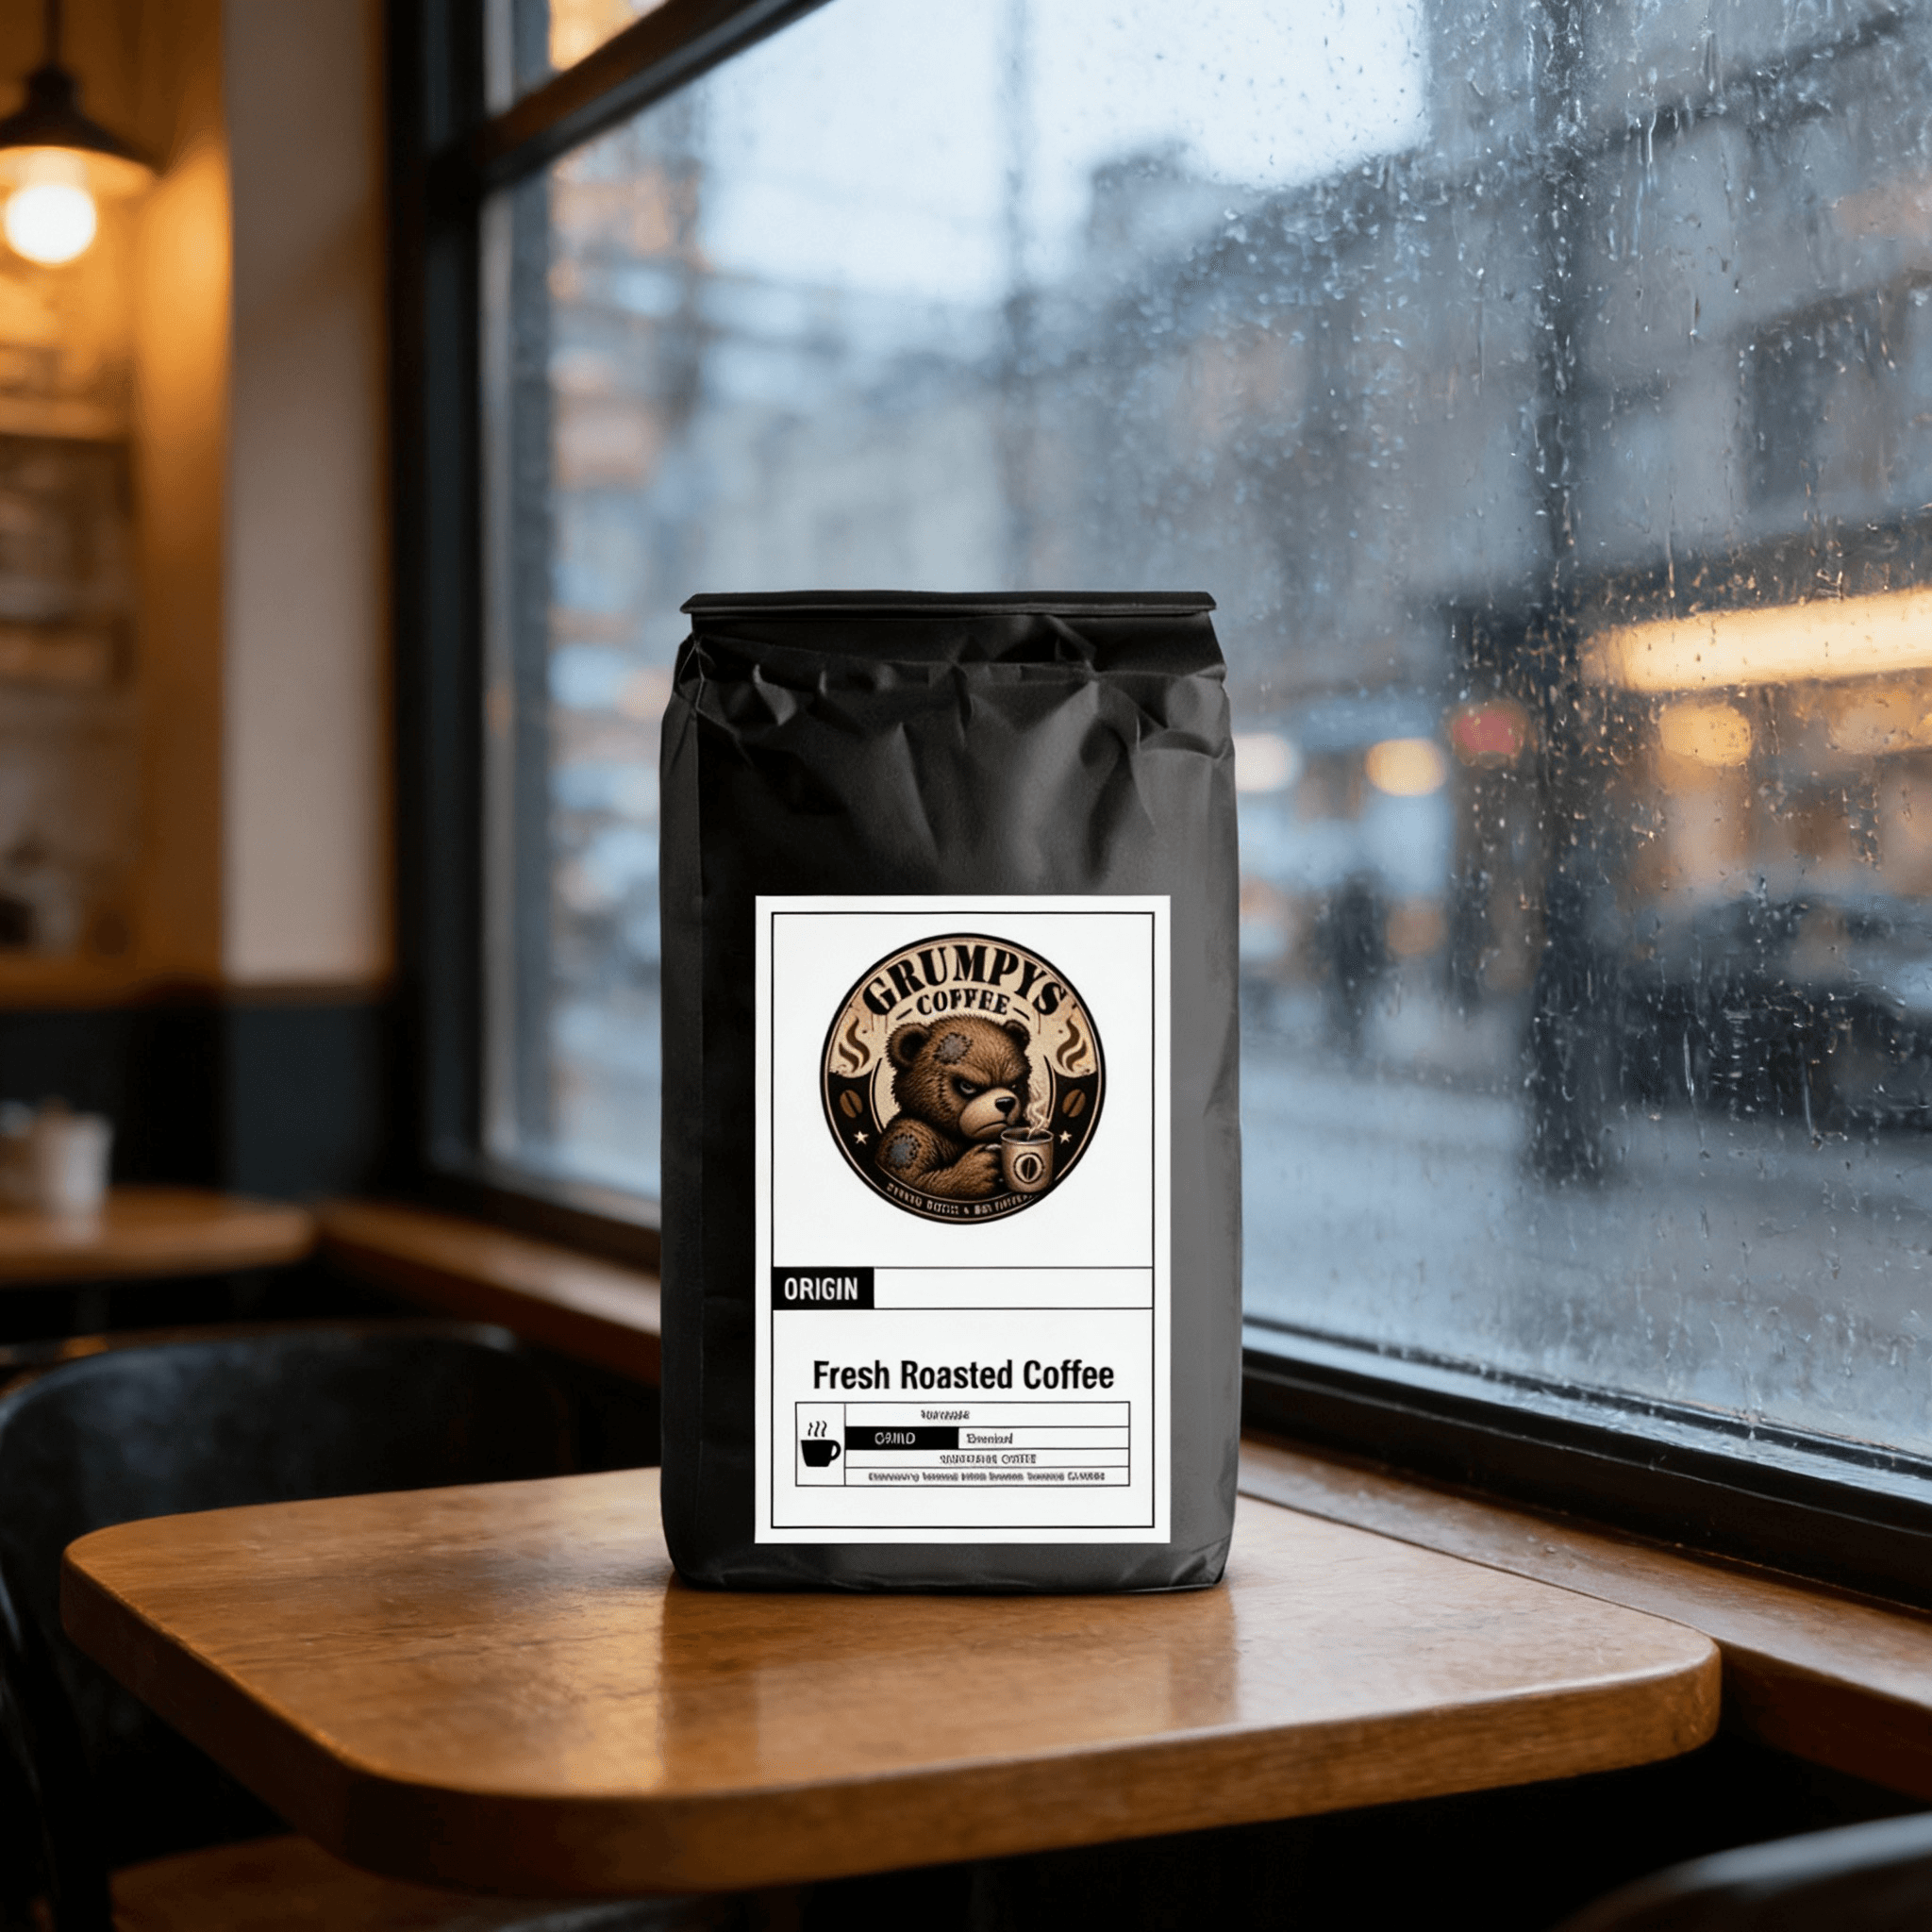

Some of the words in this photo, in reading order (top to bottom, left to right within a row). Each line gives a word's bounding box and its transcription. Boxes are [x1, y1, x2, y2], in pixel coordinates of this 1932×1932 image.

[862, 944, 1067, 1016] GRUMPYS
[916, 989, 1010, 1016] COFFEE
[784, 1276, 858, 1301] ORIGIN
[813, 1359, 890, 1390] Fresh
[900, 1359, 1013, 1390] Roasted
[1023, 1359, 1115, 1390] Coffee
